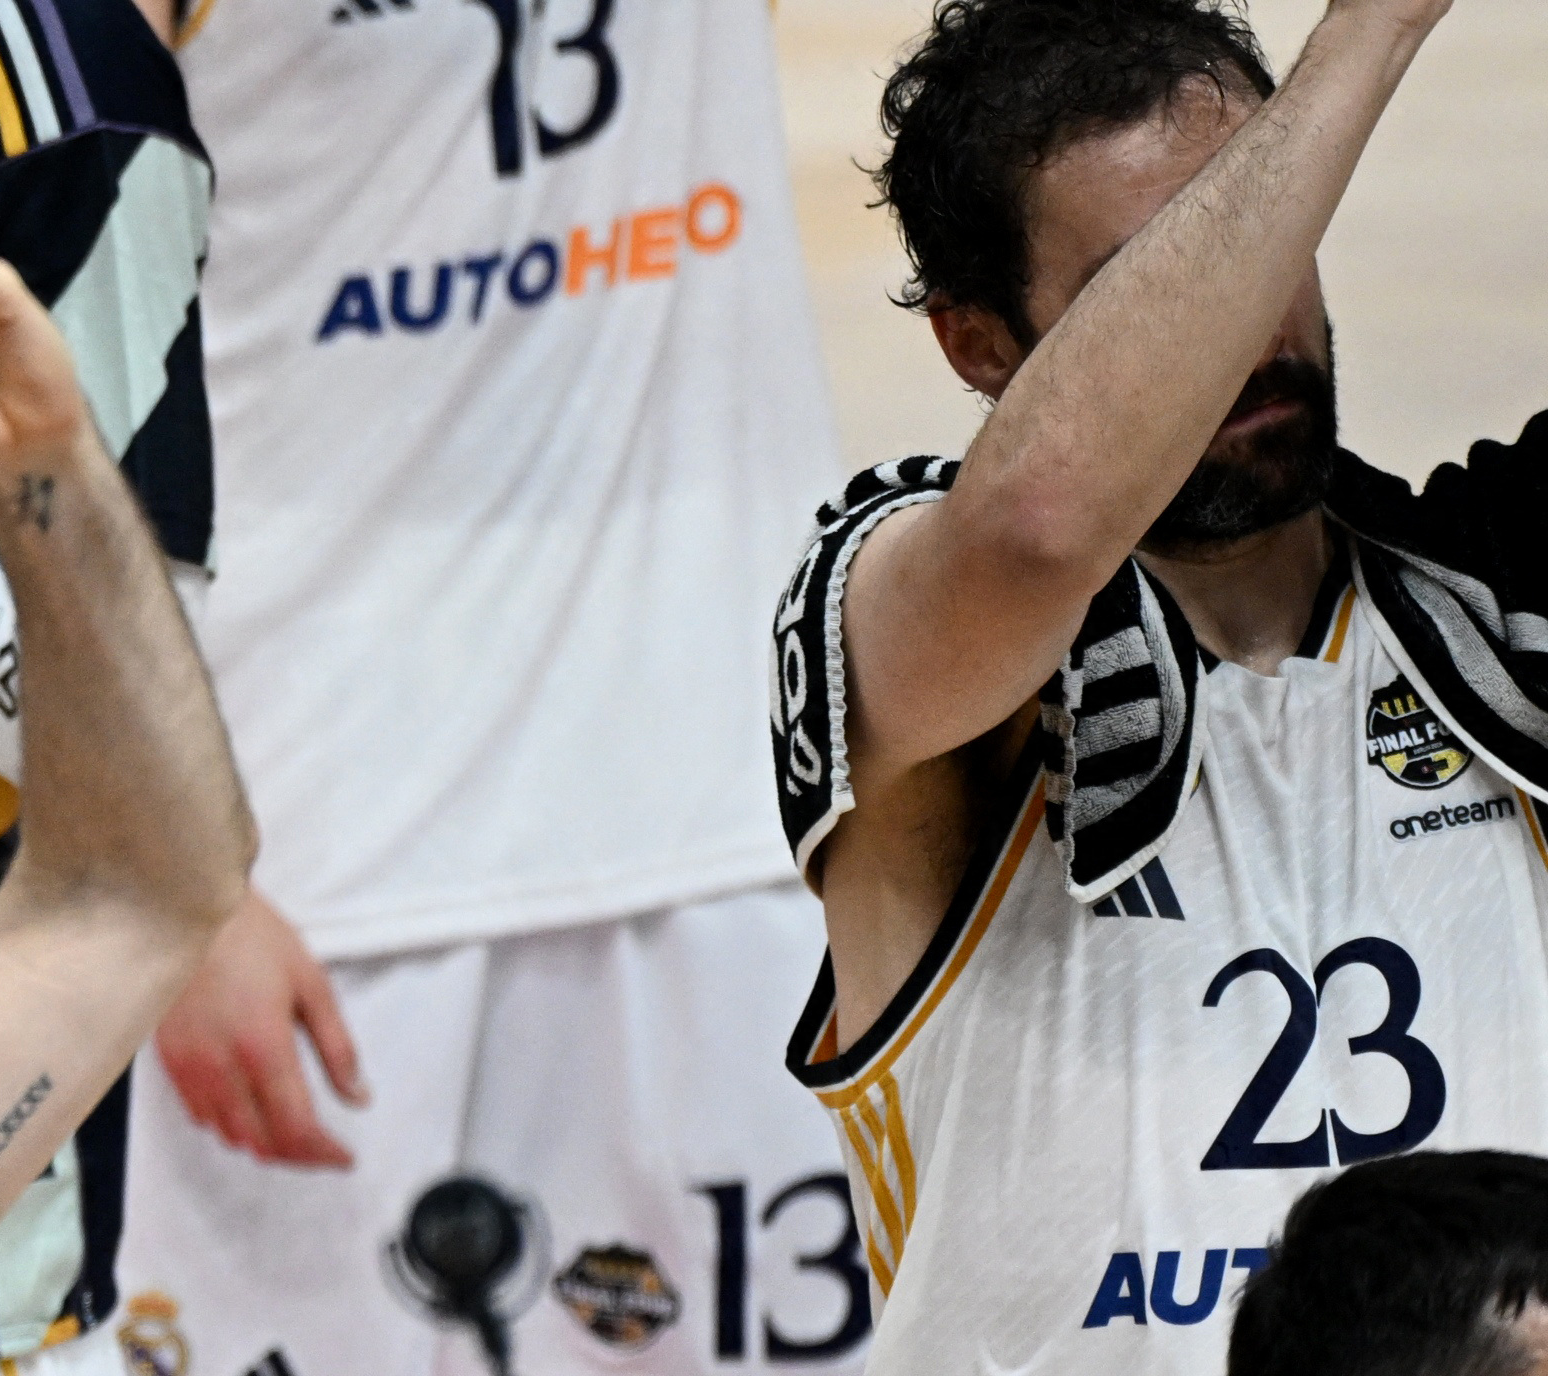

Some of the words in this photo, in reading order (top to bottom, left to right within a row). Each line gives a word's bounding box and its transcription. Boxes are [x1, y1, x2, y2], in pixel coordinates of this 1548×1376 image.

[1366, 729, 1424, 760] FINAL
[1389, 796, 1516, 840] oneteam
[1199, 935, 1447, 1171] 23
[689, 1173, 873, 1365] 13
